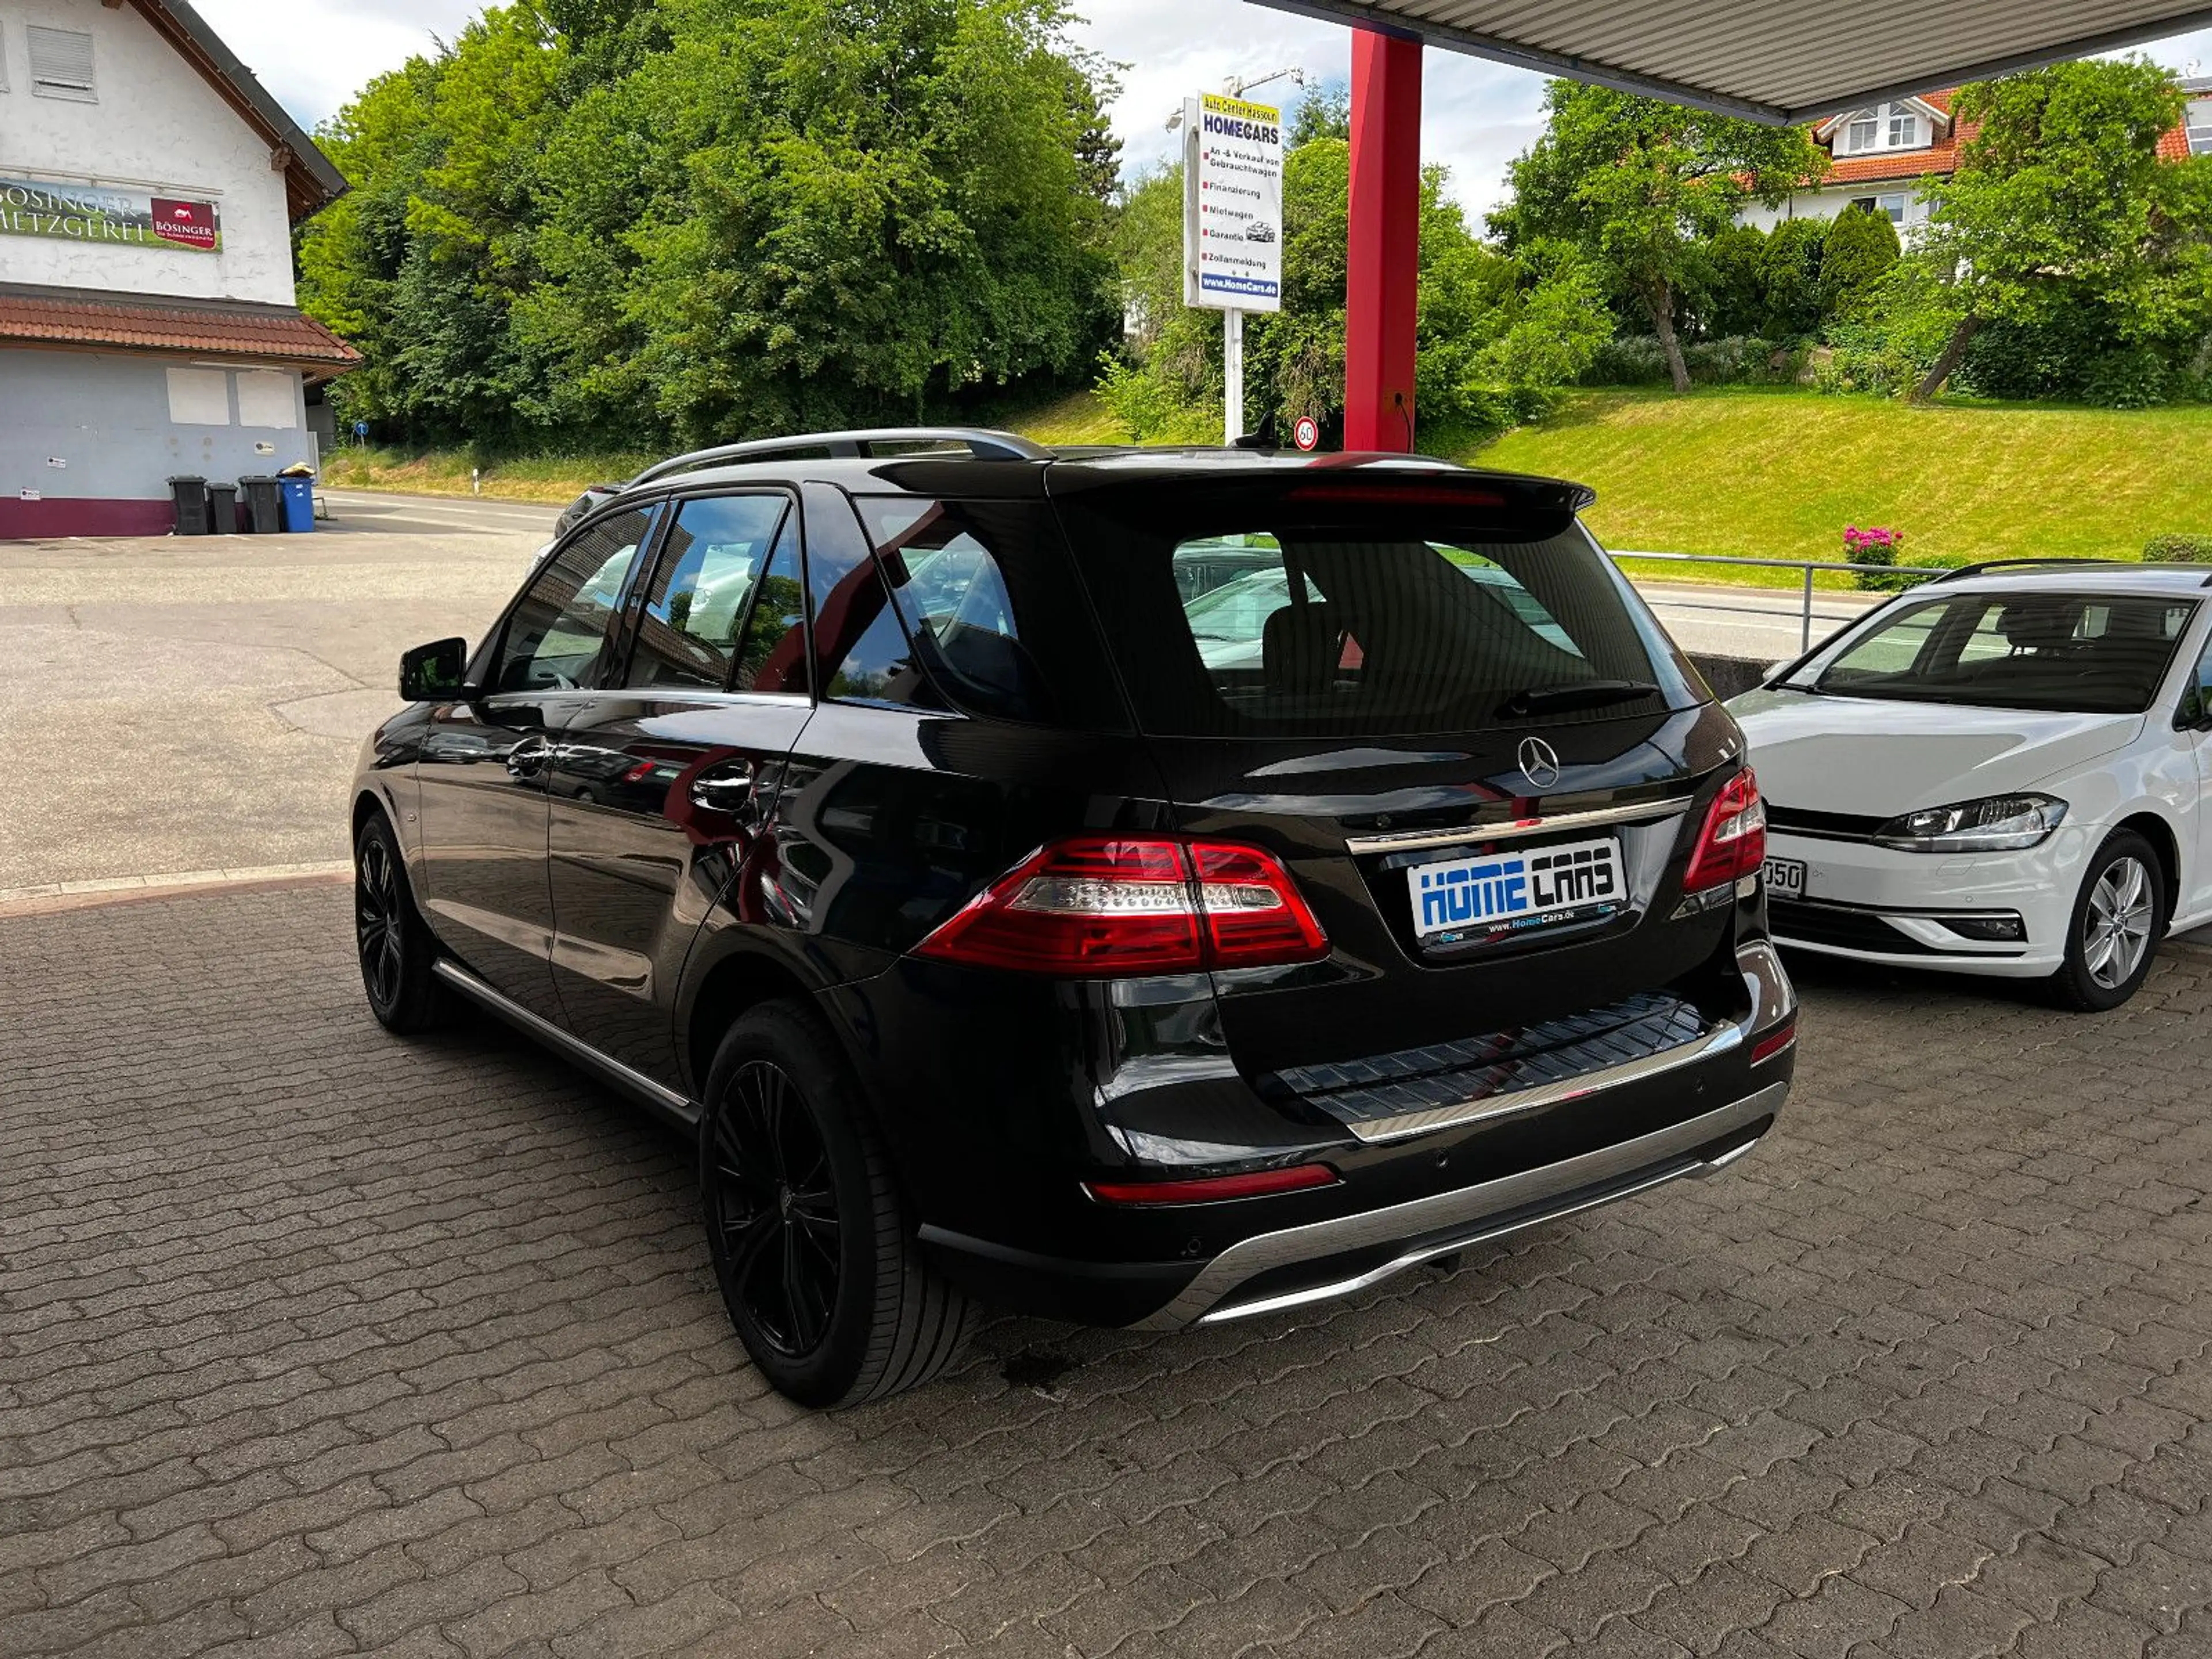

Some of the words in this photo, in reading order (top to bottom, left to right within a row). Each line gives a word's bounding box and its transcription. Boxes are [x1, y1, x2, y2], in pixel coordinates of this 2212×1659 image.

[1205, 97, 1220, 111] Auto
[1223, 100, 1246, 115] Center
[1203, 113, 1279, 145] HOMECARS
[1233, 150, 1264, 163] Verkauf
[1265, 157, 1280, 166] von
[1210, 158, 1278, 178] Gebrauchtwagen
[1210, 182, 1261, 200] Finanzierung
[1210, 206, 1254, 220] Mietwagen
[156, 221, 213, 237] BÖSINGER
[1210, 229, 1244, 241] Garantie
[1209, 253, 1267, 270] Zollanmeldung
[1202, 277, 1277, 294] www.HomeCars.de
[1300, 426, 1313, 441] 60
[1488, 911, 1575, 933] www.HomeCars.de
